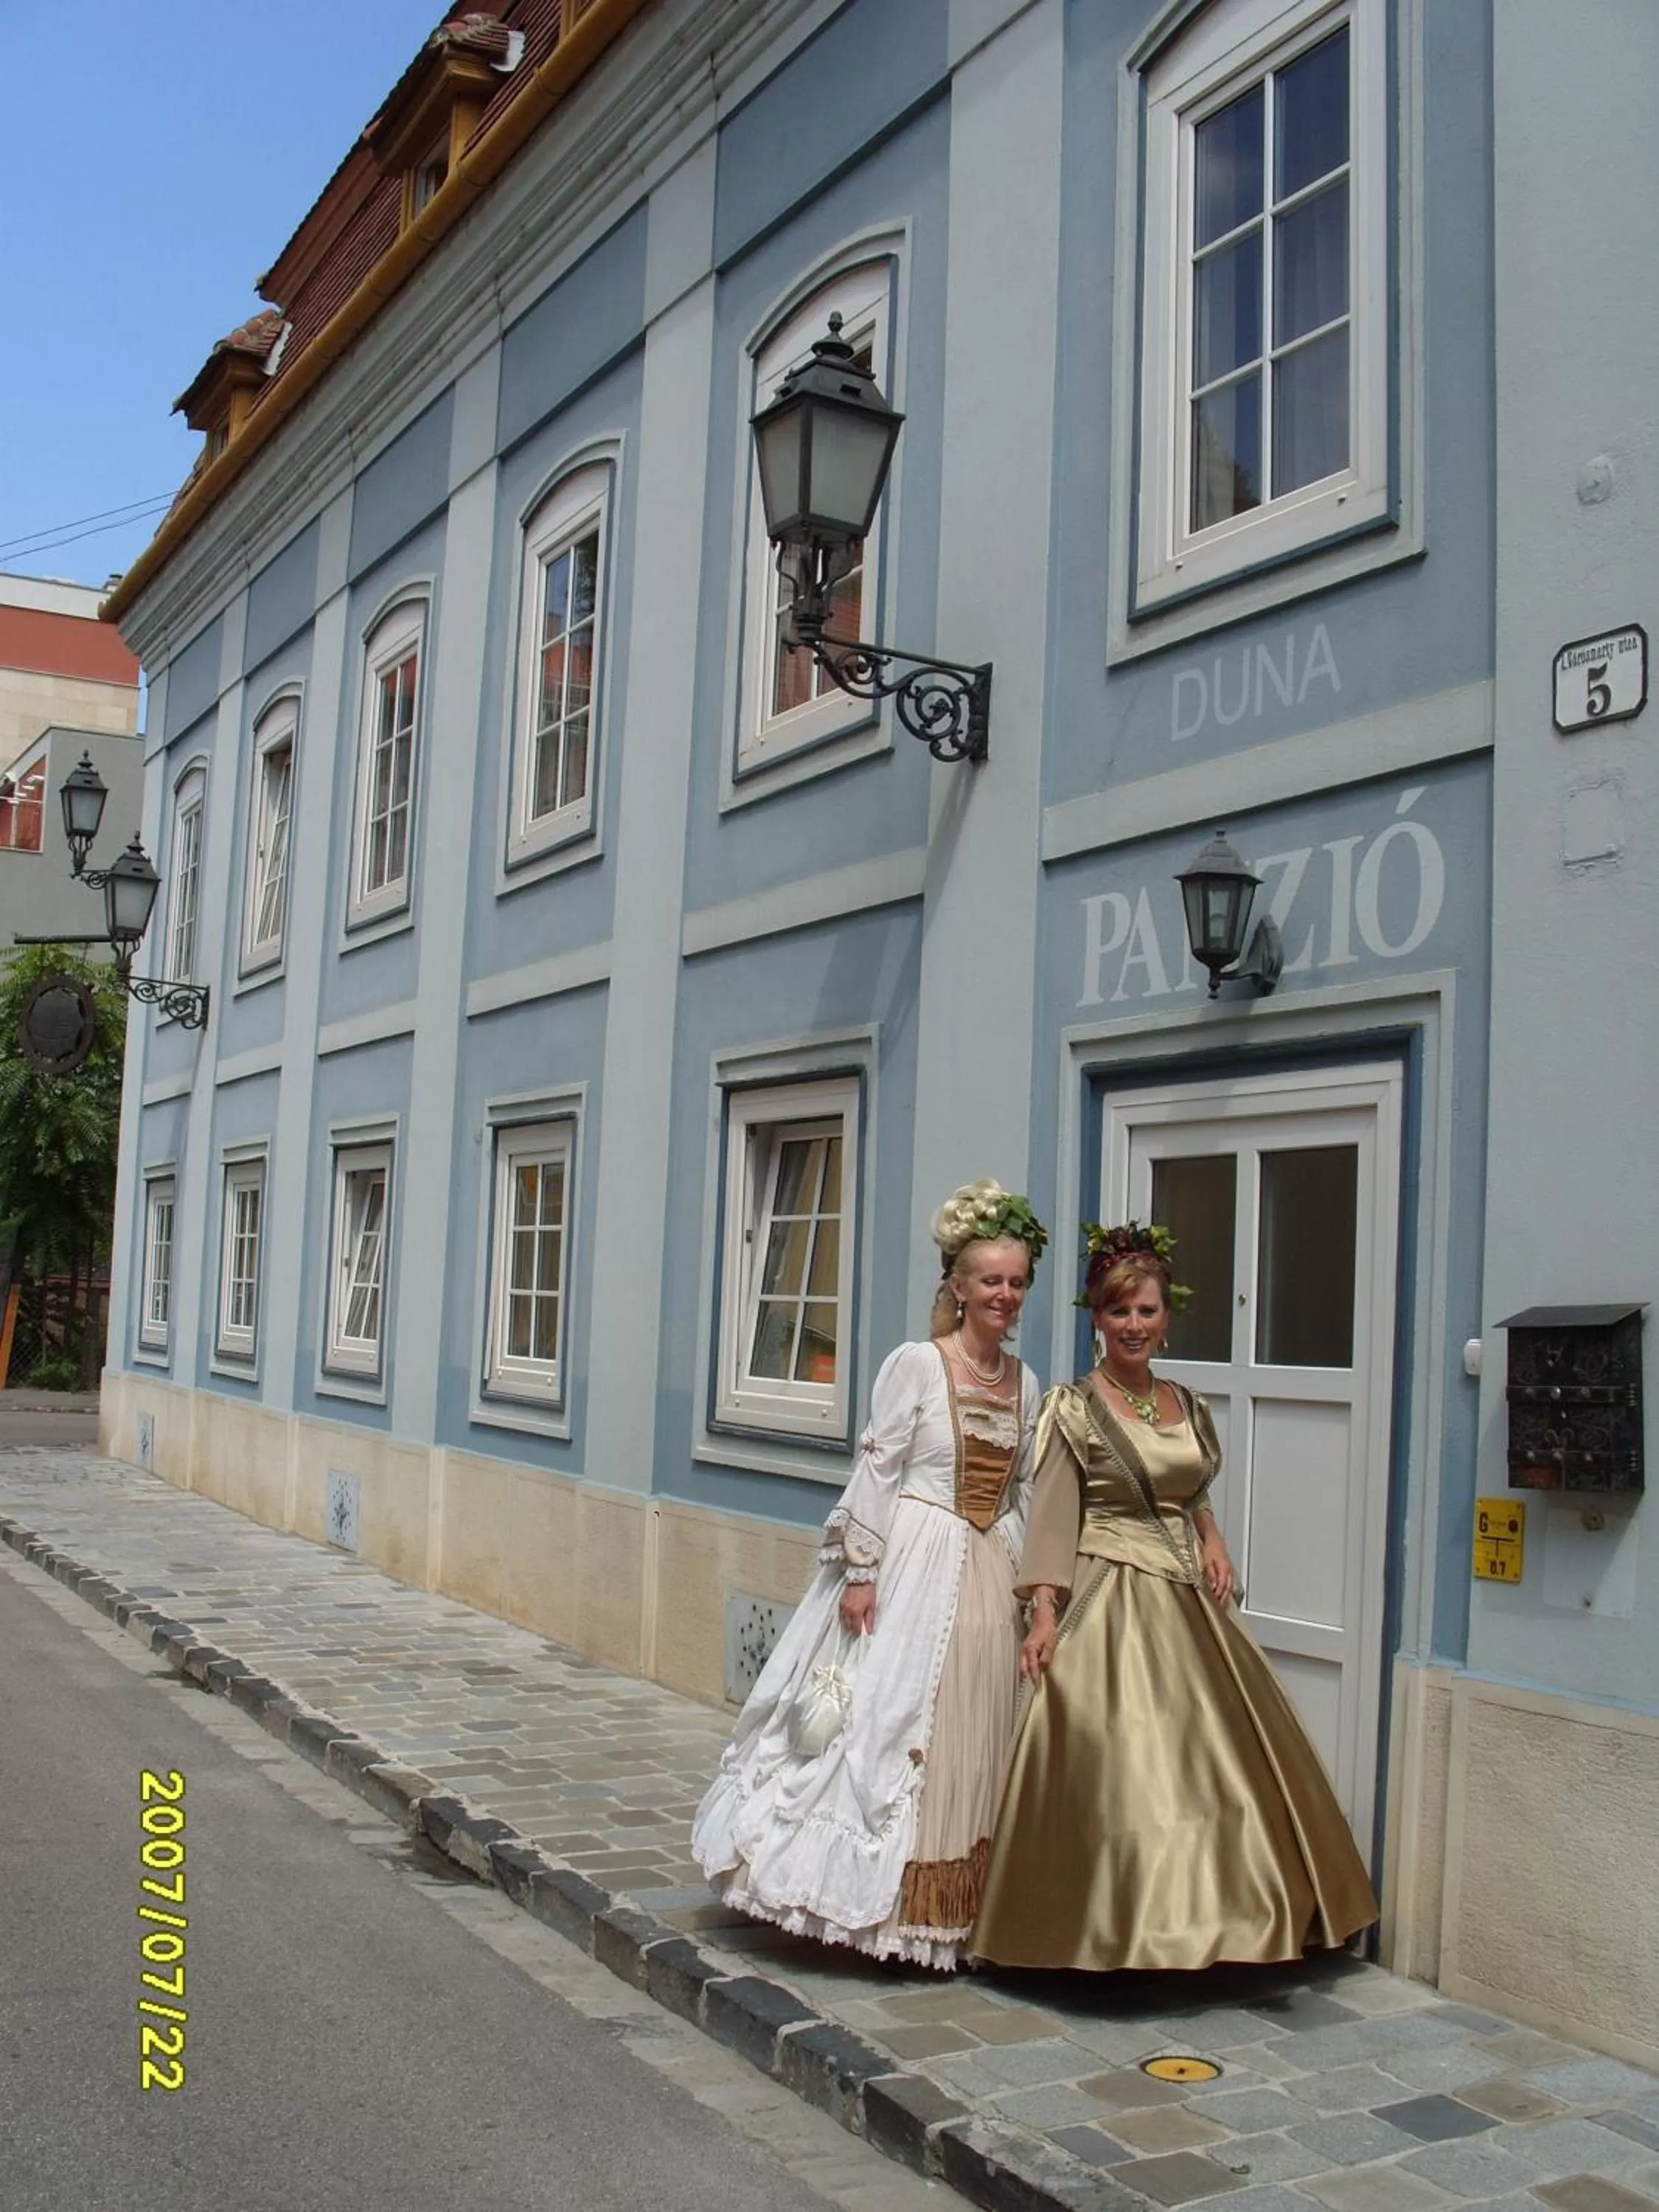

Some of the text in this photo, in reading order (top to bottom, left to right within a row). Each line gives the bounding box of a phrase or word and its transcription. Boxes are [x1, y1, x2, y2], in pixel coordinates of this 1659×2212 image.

[1171, 623, 1342, 742] DUNA
[1586, 660, 1612, 716] 5
[1076, 786, 1445, 1008] PAZIÓ
